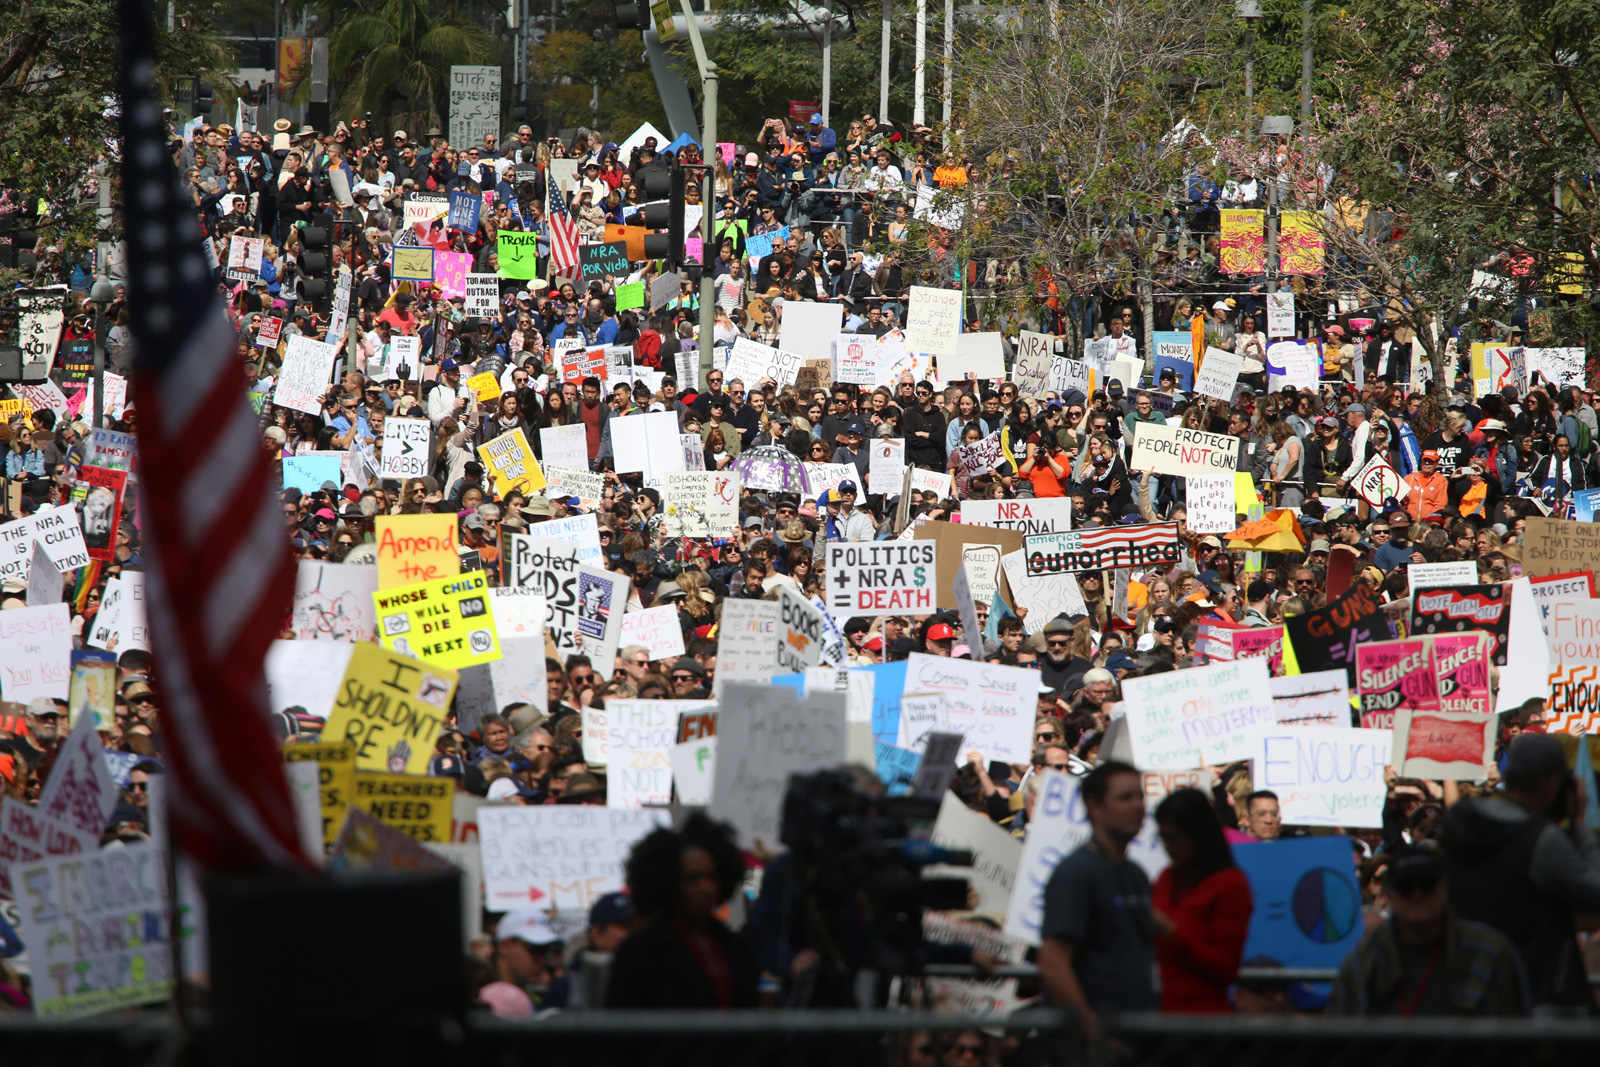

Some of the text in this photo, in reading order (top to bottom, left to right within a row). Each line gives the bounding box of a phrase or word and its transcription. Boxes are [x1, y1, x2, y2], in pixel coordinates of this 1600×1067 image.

[410, 191, 448, 203] Classroom
[455, 195, 477, 209] NOT
[406, 206, 431, 217] NOT
[454, 206, 475, 220] ONE
[452, 217, 475, 230] MORE.
[500, 234, 536, 246] TROLLS
[590, 245, 620, 259] NRA
[582, 262, 605, 276] POR
[466, 276, 498, 286] TOO MUCH
[466, 287, 498, 297] OUTRAGE
[914, 288, 957, 311] Strange
[466, 307, 499, 318] ONE SIGN
[475, 298, 490, 307] FOR
[928, 308, 953, 322] people
[558, 339, 579, 349] ARMS
[1160, 344, 1191, 356] MONEY
[65, 363, 95, 371] PISSED
[564, 355, 589, 364] SUPPORT
[577, 360, 604, 370] TEACHERS
[771, 350, 801, 370] NOT
[815, 360, 829, 369] AR
[766, 365, 795, 384] ONE
[1063, 359, 1090, 382] DEAD
[385, 422, 429, 442] LIVES
[1175, 429, 1236, 451] PROTECT
[487, 435, 518, 457] PROTECT
[1137, 437, 1237, 470] PEOPLE NOT GUNS
[382, 456, 428, 476] HOBBY
[491, 447, 525, 471] KIDS NOT
[504, 464, 526, 480] GUNS
[669, 474, 709, 484] DISHONOR
[812, 466, 851, 484] HOW MUCH
[1364, 470, 1386, 493] NRA
[923, 475, 945, 491] HOBBY
[668, 492, 707, 502] DISHONOR
[1209, 490, 1225, 499] was
[998, 502, 1033, 520] NRA
[1196, 510, 1207, 522] by
[2, 513, 65, 542] THE NRA
[541, 519, 590, 537] YOU NEED
[1544, 520, 1600, 538] THE ONLY
[14, 525, 81, 555] IS CULT!
[377, 524, 462, 559] Amend
[1028, 533, 1082, 545] america
[1058, 541, 1082, 551] has
[1540, 535, 1600, 549] THAT STOP
[515, 538, 580, 572] Protect
[831, 544, 934, 568] POLITICS
[964, 553, 996, 563] BULLETS
[1029, 540, 1178, 574] Gunorrhea
[1528, 546, 1585, 561] BAD GUY
[397, 560, 448, 582] the
[858, 568, 907, 588] NRA
[378, 577, 485, 609] WHOSE CHILD
[516, 564, 577, 607] KIDS
[1532, 580, 1586, 598] PROTECT
[458, 598, 485, 614] NO
[857, 588, 931, 610] DEATH
[1419, 594, 1503, 621] VOTE THEM OUT
[414, 603, 451, 620] WILL
[621, 610, 671, 632] BOOKS
[782, 592, 820, 643] BOOKS
[1306, 583, 1377, 639] GUNS
[422, 618, 452, 634] DIE
[636, 627, 660, 642] NOT
[1208, 626, 1232, 640] Peop
[421, 637, 464, 657] NEXT
[787, 626, 810, 655] NOT
[918, 661, 969, 688] COMMON
[1360, 640, 1432, 691] SILENCE!
[1460, 662, 1487, 688] GUN
[381, 658, 421, 694] I
[1405, 670, 1438, 698] GUN
[1136, 674, 1199, 702] Students
[1552, 682, 1600, 713] ENOU
[1364, 690, 1401, 712] END
[608, 702, 671, 727] THIS
[1145, 703, 1175, 724] the
[1180, 703, 1275, 747] MIDTERMS
[607, 727, 678, 750] SCHOO
[629, 750, 673, 770] ZON
[1263, 736, 1388, 787] ENOUGH
[356, 779, 448, 798] TEACHERS
[621, 767, 664, 793] NOT
[369, 800, 432, 820] NEED
